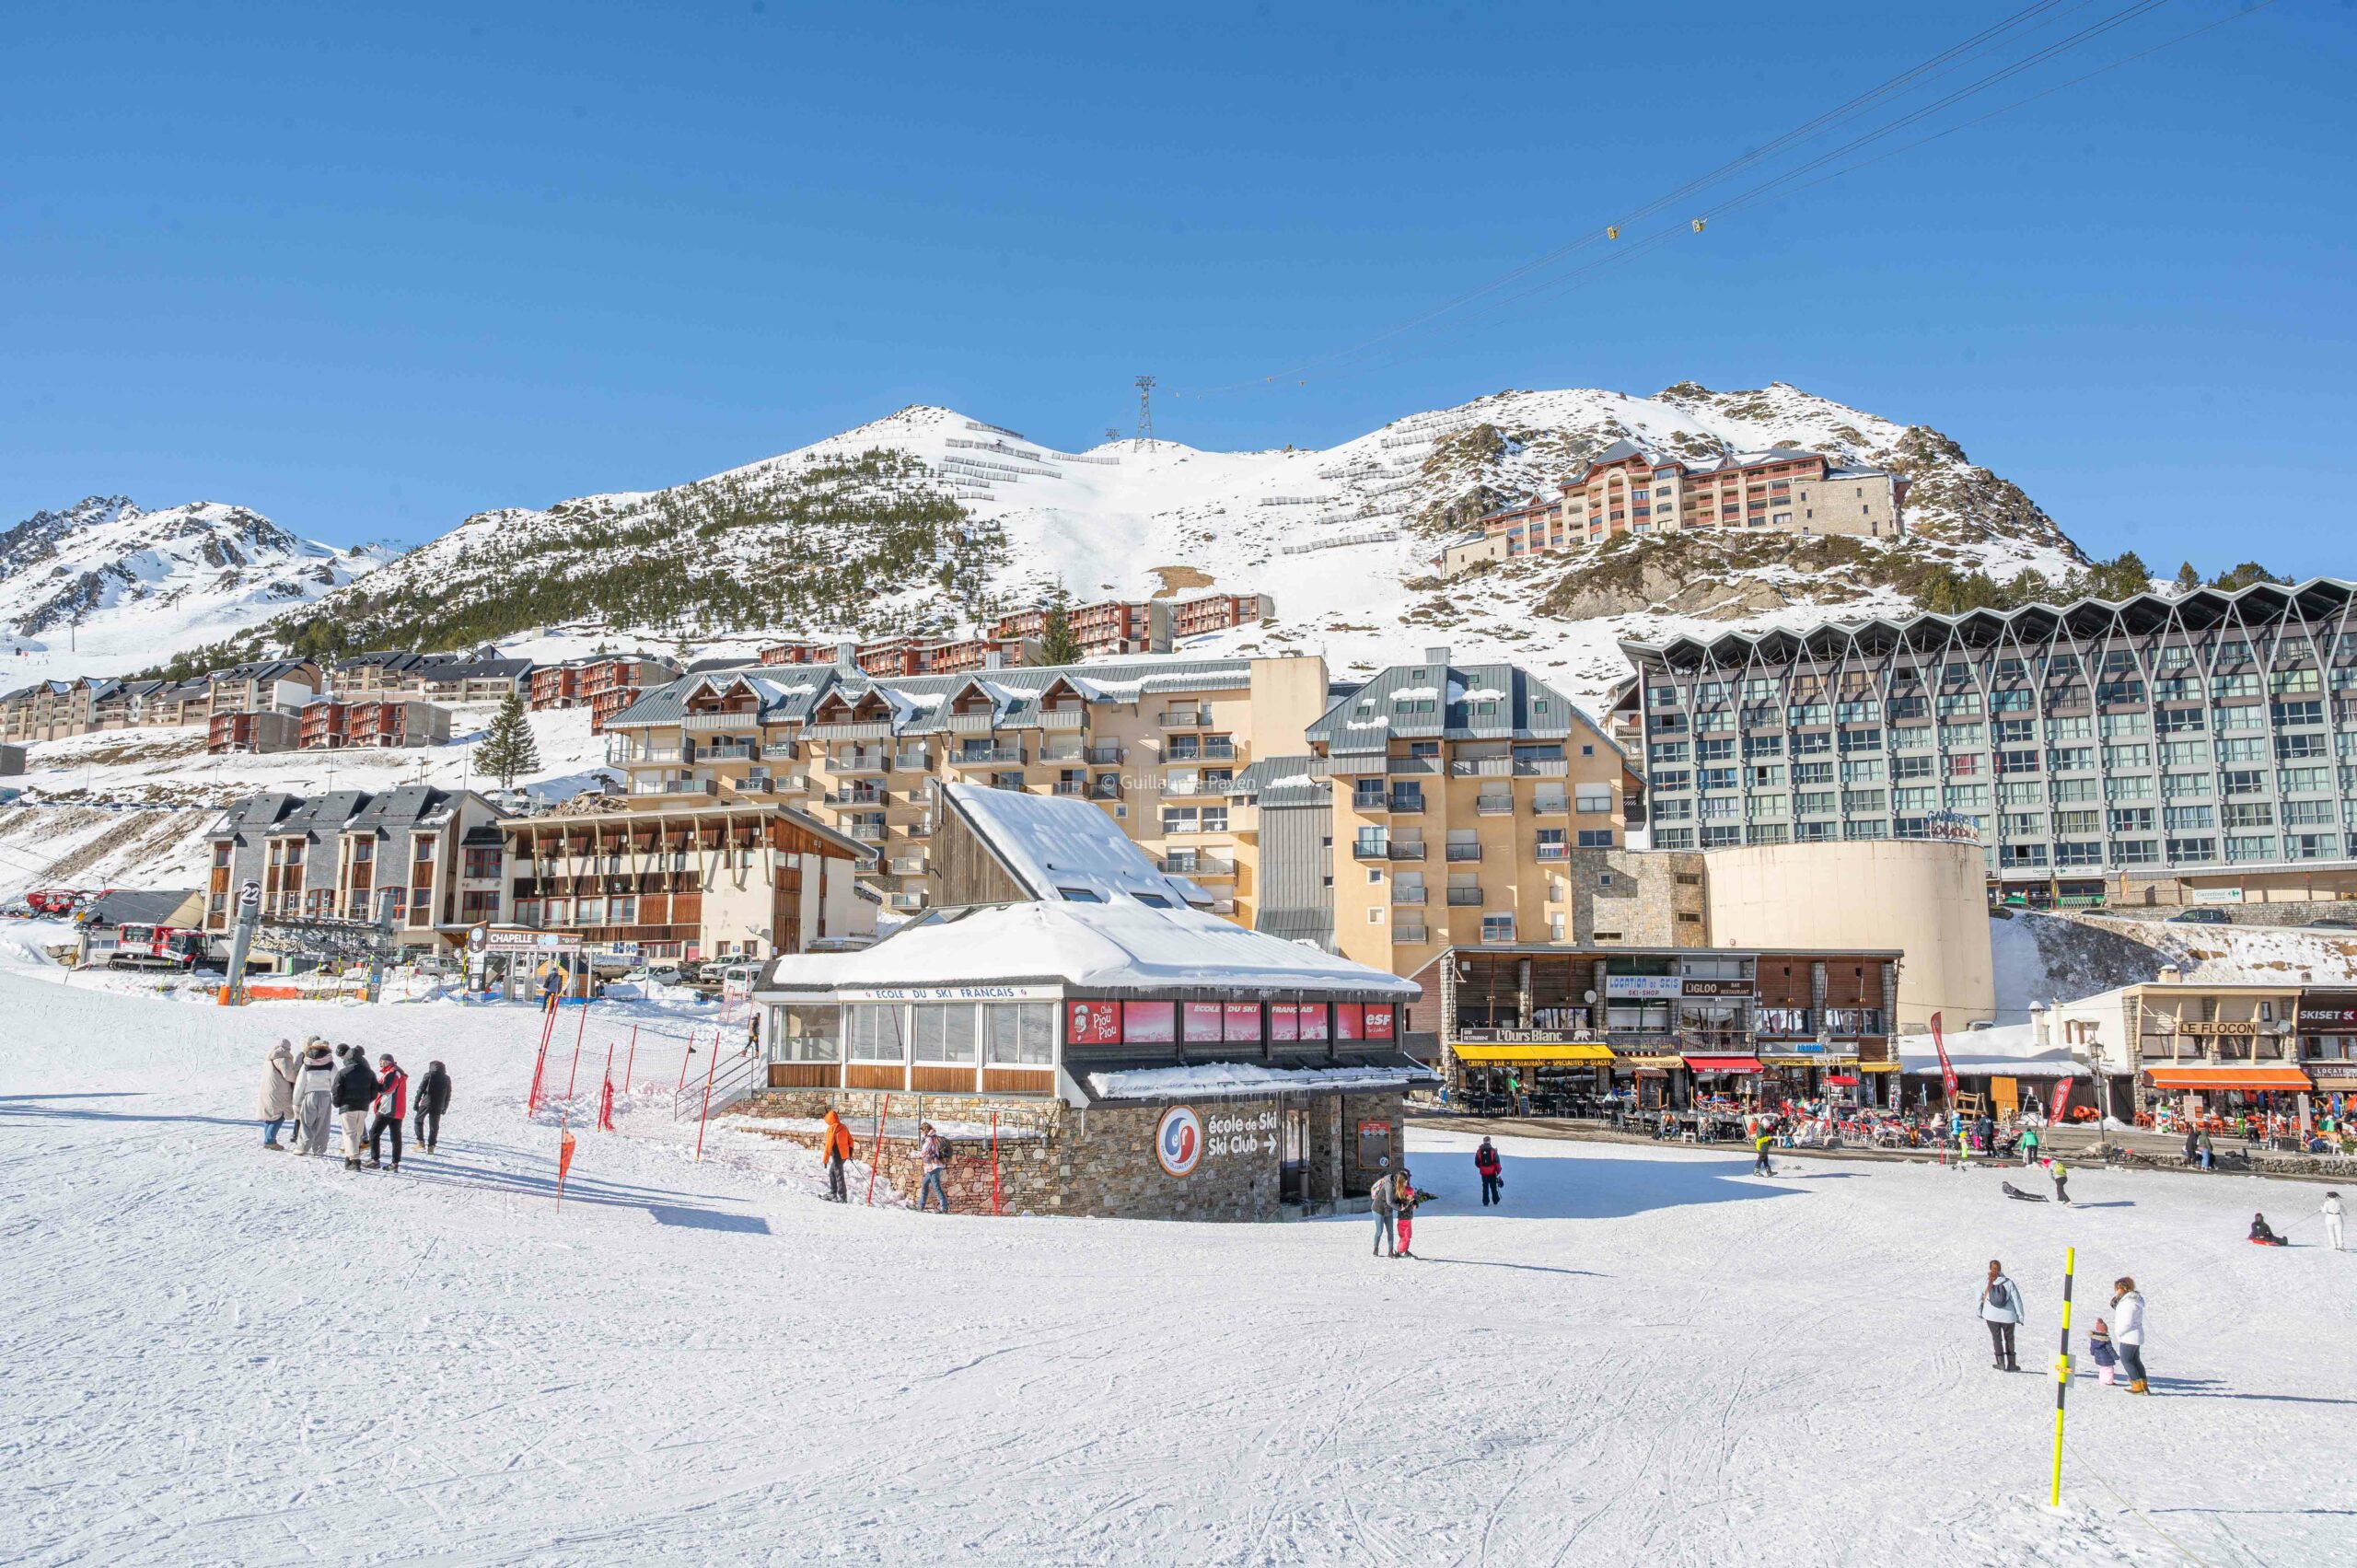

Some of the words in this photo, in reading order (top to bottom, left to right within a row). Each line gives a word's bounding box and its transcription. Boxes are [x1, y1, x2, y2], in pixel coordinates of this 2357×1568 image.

[241, 887, 260, 900] 22
[490, 934, 532, 943] CHAPELLE
[1609, 978, 1646, 988] LOCATION
[1660, 978, 1678, 988] SKIS
[1686, 983, 1717, 993] L'IGLOO
[913, 990, 927, 998] DU
[936, 989, 952, 998] SKI
[961, 988, 1014, 997] FRANCAIS
[1101, 1005, 1112, 1014] Club
[2299, 1011, 2340, 1019] SKISET
[1093, 1014, 1111, 1028] Piou
[1098, 1026, 1116, 1040] Piou
[2180, 1024, 2196, 1033] LE
[2202, 1023, 2256, 1034] FLOCON
[1496, 1029, 1530, 1041] L'Ours
[1532, 1029, 1562, 1041] Blanc
[1208, 1114, 1243, 1134] école
[1245, 1118, 1257, 1131] de
[1259, 1111, 1277, 1131] Ski
[1208, 1136, 1227, 1156] Ski
[1230, 1134, 1258, 1154] Club
